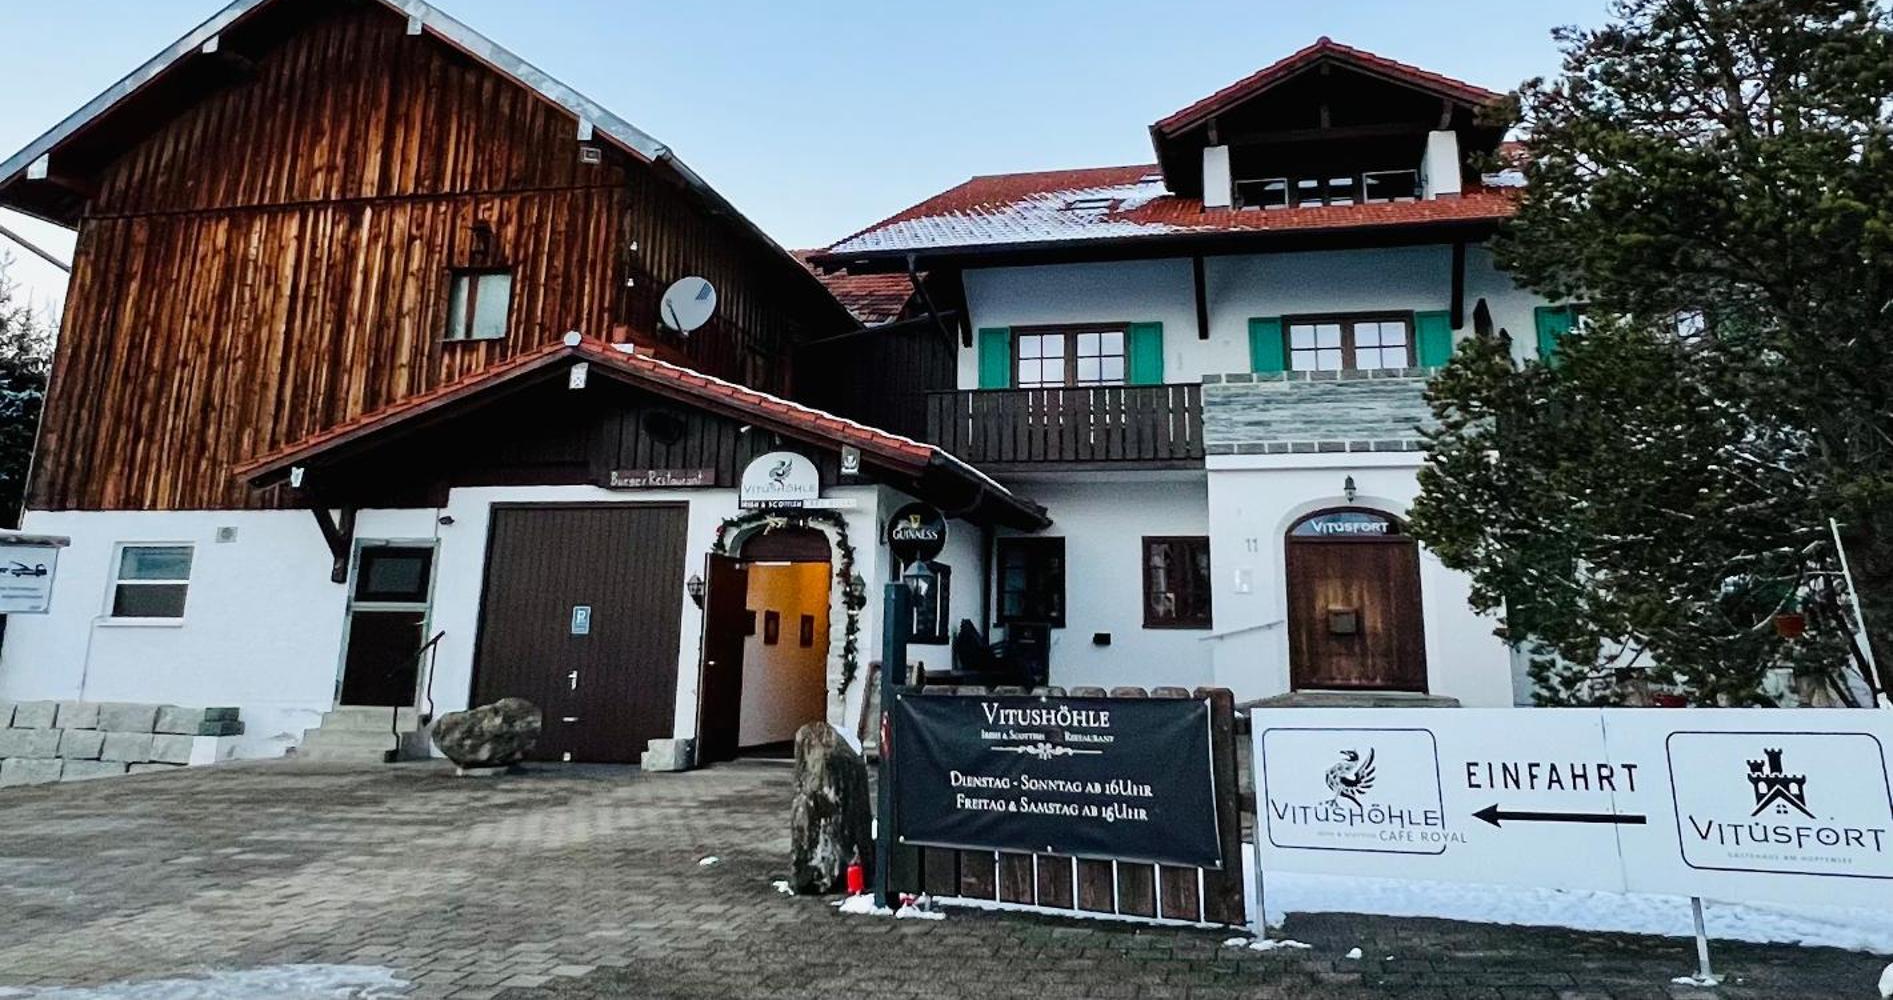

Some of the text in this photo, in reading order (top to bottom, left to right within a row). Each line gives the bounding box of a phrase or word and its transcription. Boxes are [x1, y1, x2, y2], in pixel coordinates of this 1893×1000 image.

[647, 470, 703, 486] Restaurant
[893, 526, 938, 540] GUINNESS
[1246, 538, 1258, 552] 11
[981, 702, 1110, 728] VITUSHÖHLE
[950, 770, 1010, 789] DIENSTAG
[1021, 774, 1082, 793] SONNTAG
[1085, 782, 1101, 794] AB
[1466, 762, 1638, 792] EINFAHRT
[957, 793, 1006, 812] FREITAG
[1008, 801, 1018, 812] &
[1020, 797, 1079, 816] SAMSTAG
[1082, 804, 1098, 816] AB
[1379, 830, 1414, 842] CAFE
[1421, 831, 1467, 844] ROYAL
